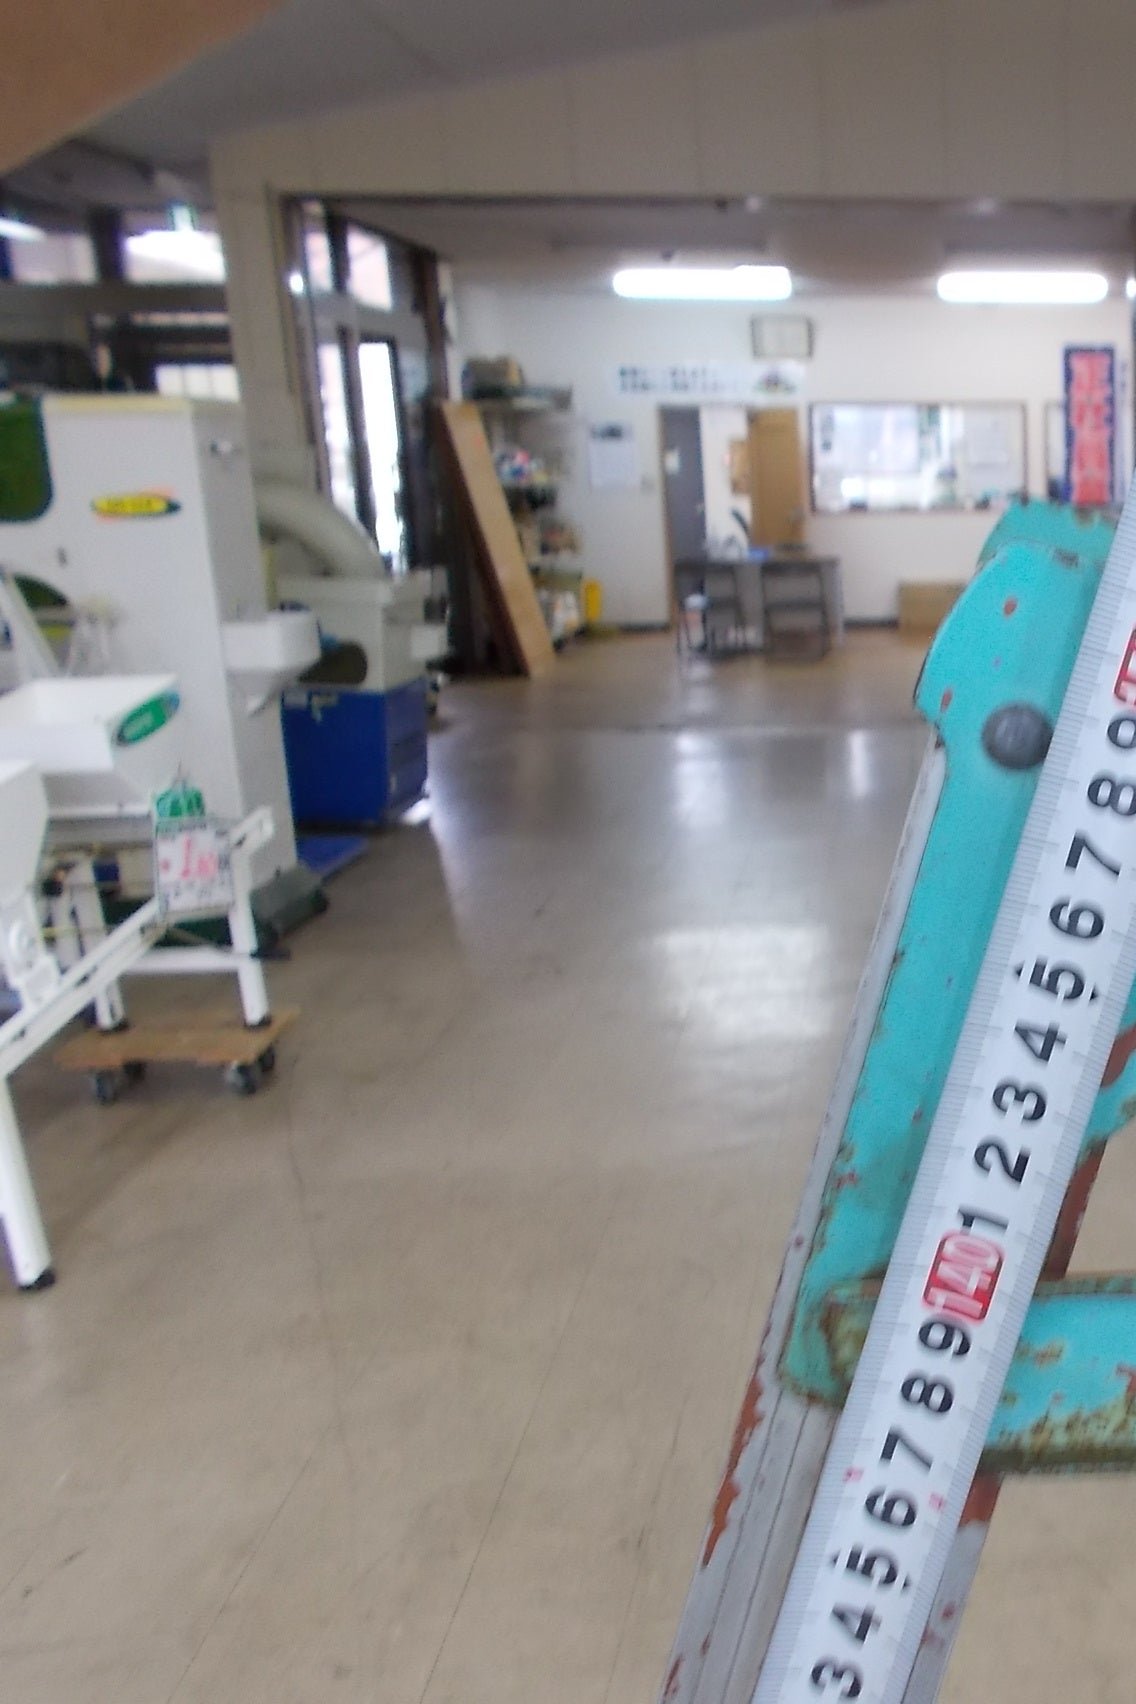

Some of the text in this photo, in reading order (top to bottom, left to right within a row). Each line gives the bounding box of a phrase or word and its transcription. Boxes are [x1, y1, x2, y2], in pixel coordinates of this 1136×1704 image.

[1065, 830, 1122, 878] 7
[1050, 896, 1104, 939] 6
[1029, 955, 1085, 1000] 5
[1014, 1020, 1068, 1062] 4
[992, 1077, 1047, 1121] 3
[974, 1135, 1031, 1184] 2
[957, 1205, 1009, 1232] 1
[926, 1234, 1001, 1319] 140
[918, 1314, 971, 1356] 9
[901, 1371, 953, 1413] 8
[880, 1424, 934, 1471] 7
[865, 1487, 917, 1527] 6
[845, 1543, 898, 1585] 5
[831, 1603, 882, 1645] 4
[810, 1656, 862, 1699] 3
